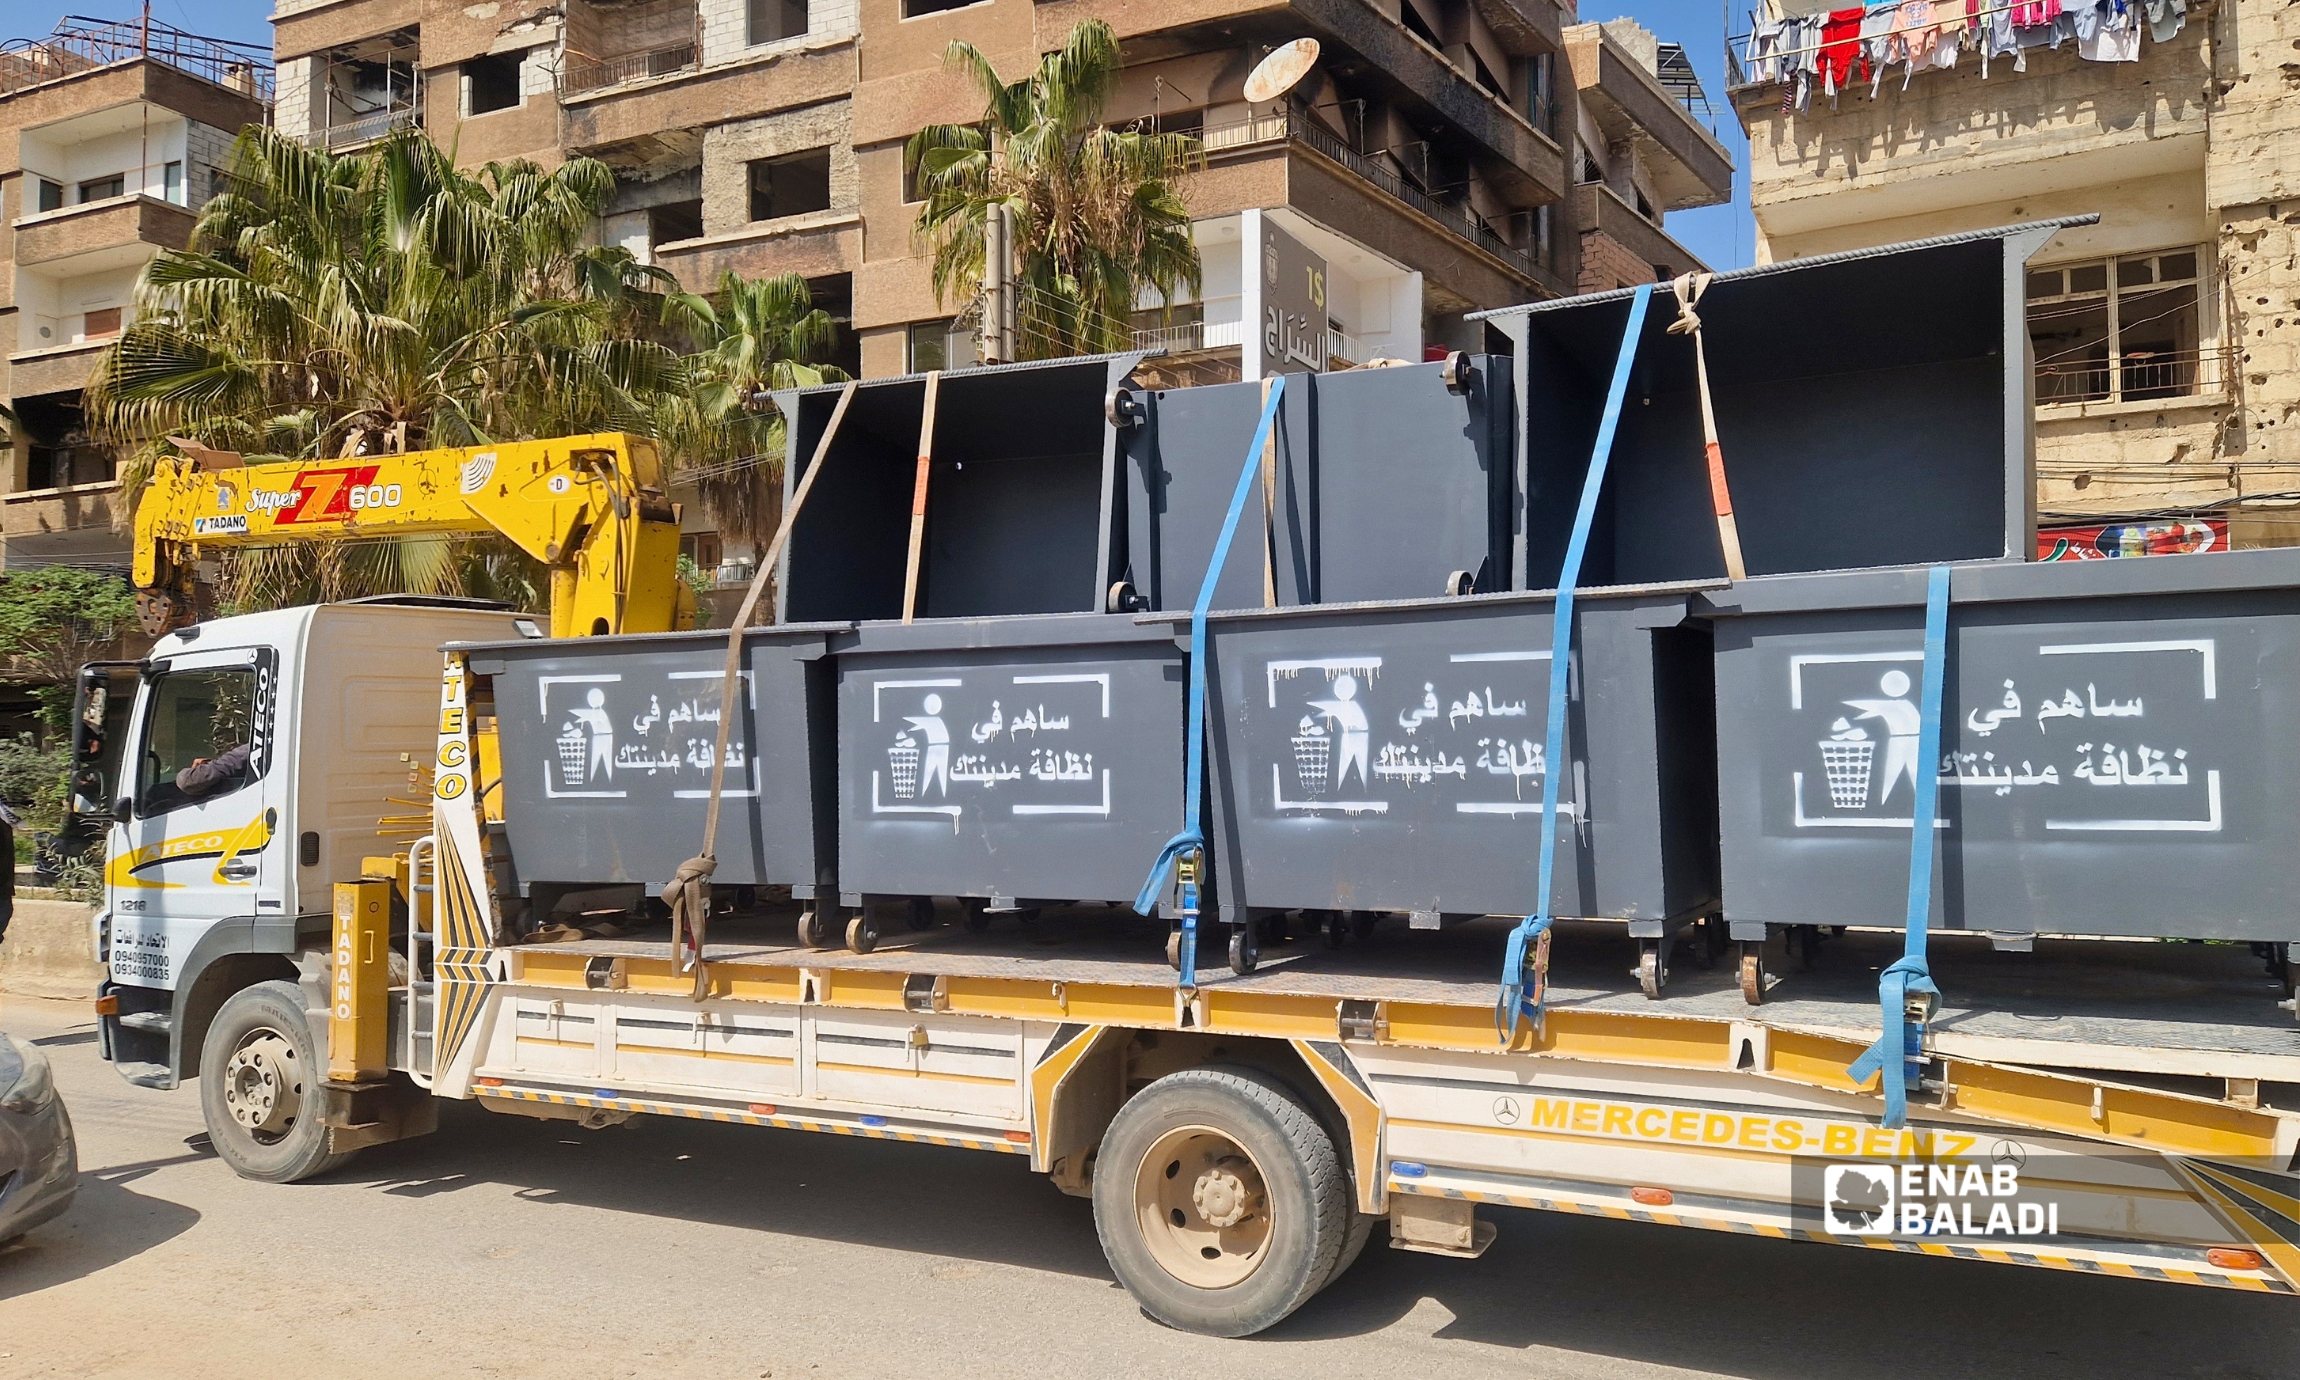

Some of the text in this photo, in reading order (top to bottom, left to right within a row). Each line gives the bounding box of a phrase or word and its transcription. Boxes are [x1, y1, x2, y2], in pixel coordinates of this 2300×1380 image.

[1306, 265, 1325, 312] 1$
[246, 487, 300, 517] Super
[350, 484, 402, 509] 600
[556, 478, 563, 491] D
[210, 516, 246, 530] TADANO
[250, 667, 268, 780] ATECO
[435, 651, 467, 800] ATECO
[633, 694, 721, 735] ساهم في
[971, 700, 1069, 744] ساهم في
[1399, 681, 1526, 735] ساهم في
[1967, 679, 2143, 737] ساهم في
[615, 743, 681, 776] مدينتك
[950, 748, 1093, 787] نظافة مدينتك
[1373, 737, 1546, 783] ظافة مدينتك
[1936, 742, 2189, 796] نظافة مدينتك
[141, 836, 223, 862] ATECO
[121, 900, 146, 911] 1218
[115, 963, 169, 980] 0934000835
[337, 915, 351, 1019] TADANO
[1530, 1098, 1977, 1166] MERCEDES-BENZ
